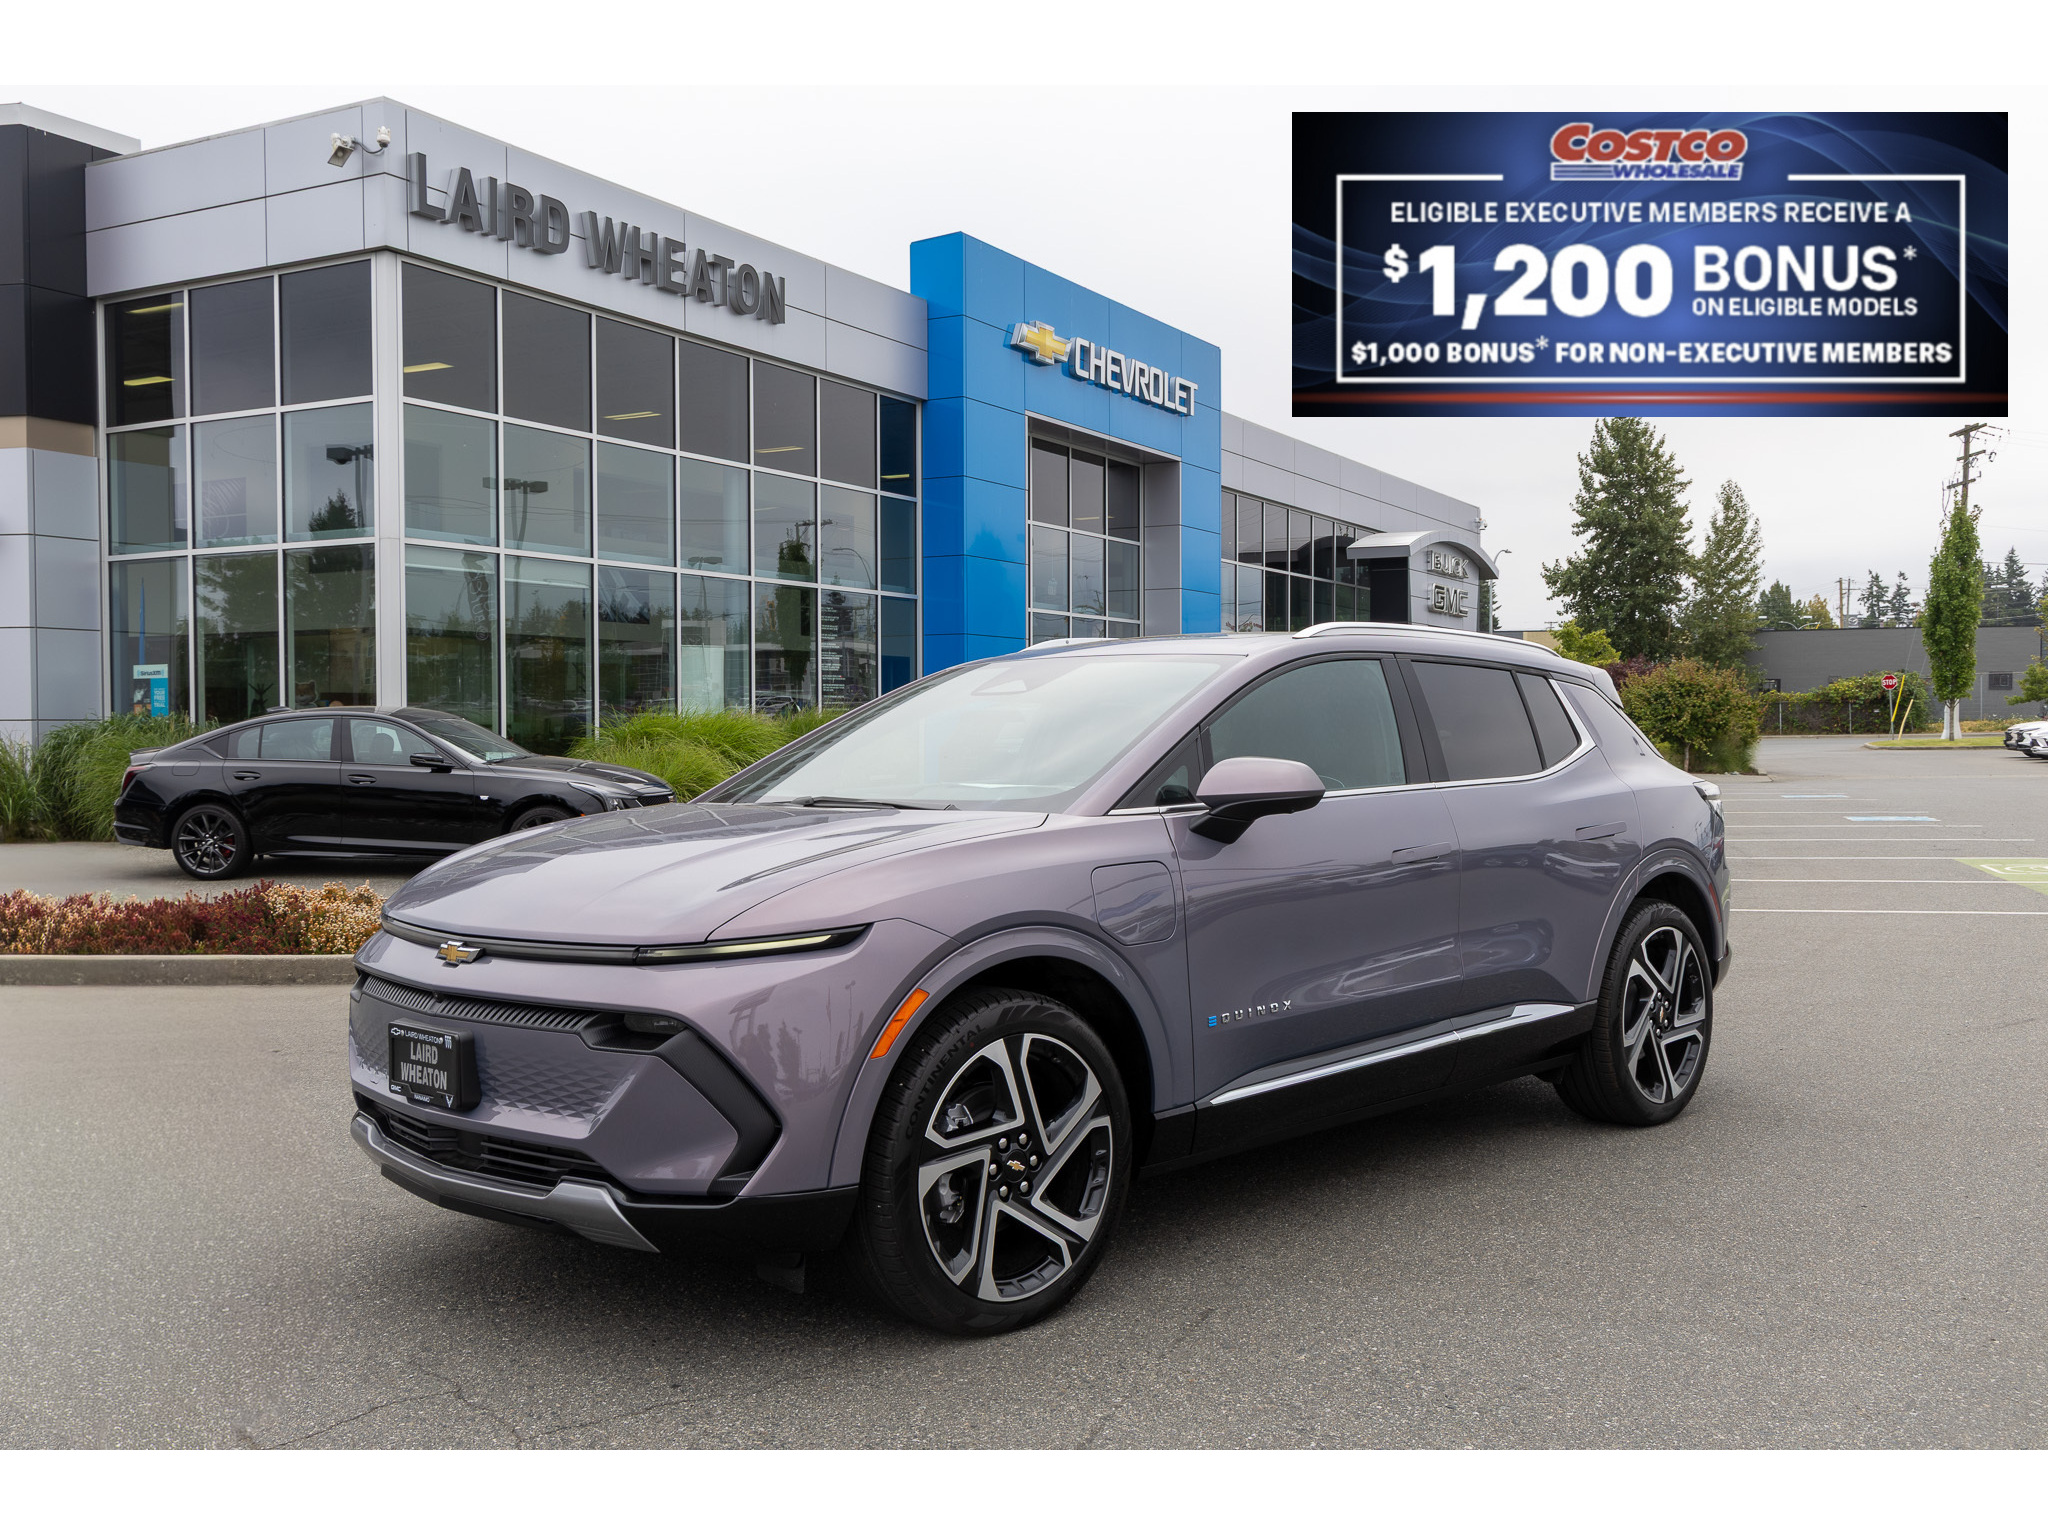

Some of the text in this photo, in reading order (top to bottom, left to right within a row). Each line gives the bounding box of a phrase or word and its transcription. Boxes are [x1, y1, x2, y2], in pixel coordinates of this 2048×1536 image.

[408, 152, 786, 324] LAIRD WHEATON
[1071, 337, 1198, 416] CHEVROLET
[1431, 551, 1469, 578] BUICK
[1431, 583, 1469, 617] GMC
[1208, 1000, 1292, 1028] EQUINOX
[404, 1030, 442, 1044] LAIRD WHEATON
[410, 1041, 438, 1065] LAIRD
[390, 1084, 402, 1092] GMC
[400, 1061, 448, 1091] WHEATON
[905, 1024, 987, 1140] CONTINENTAL
